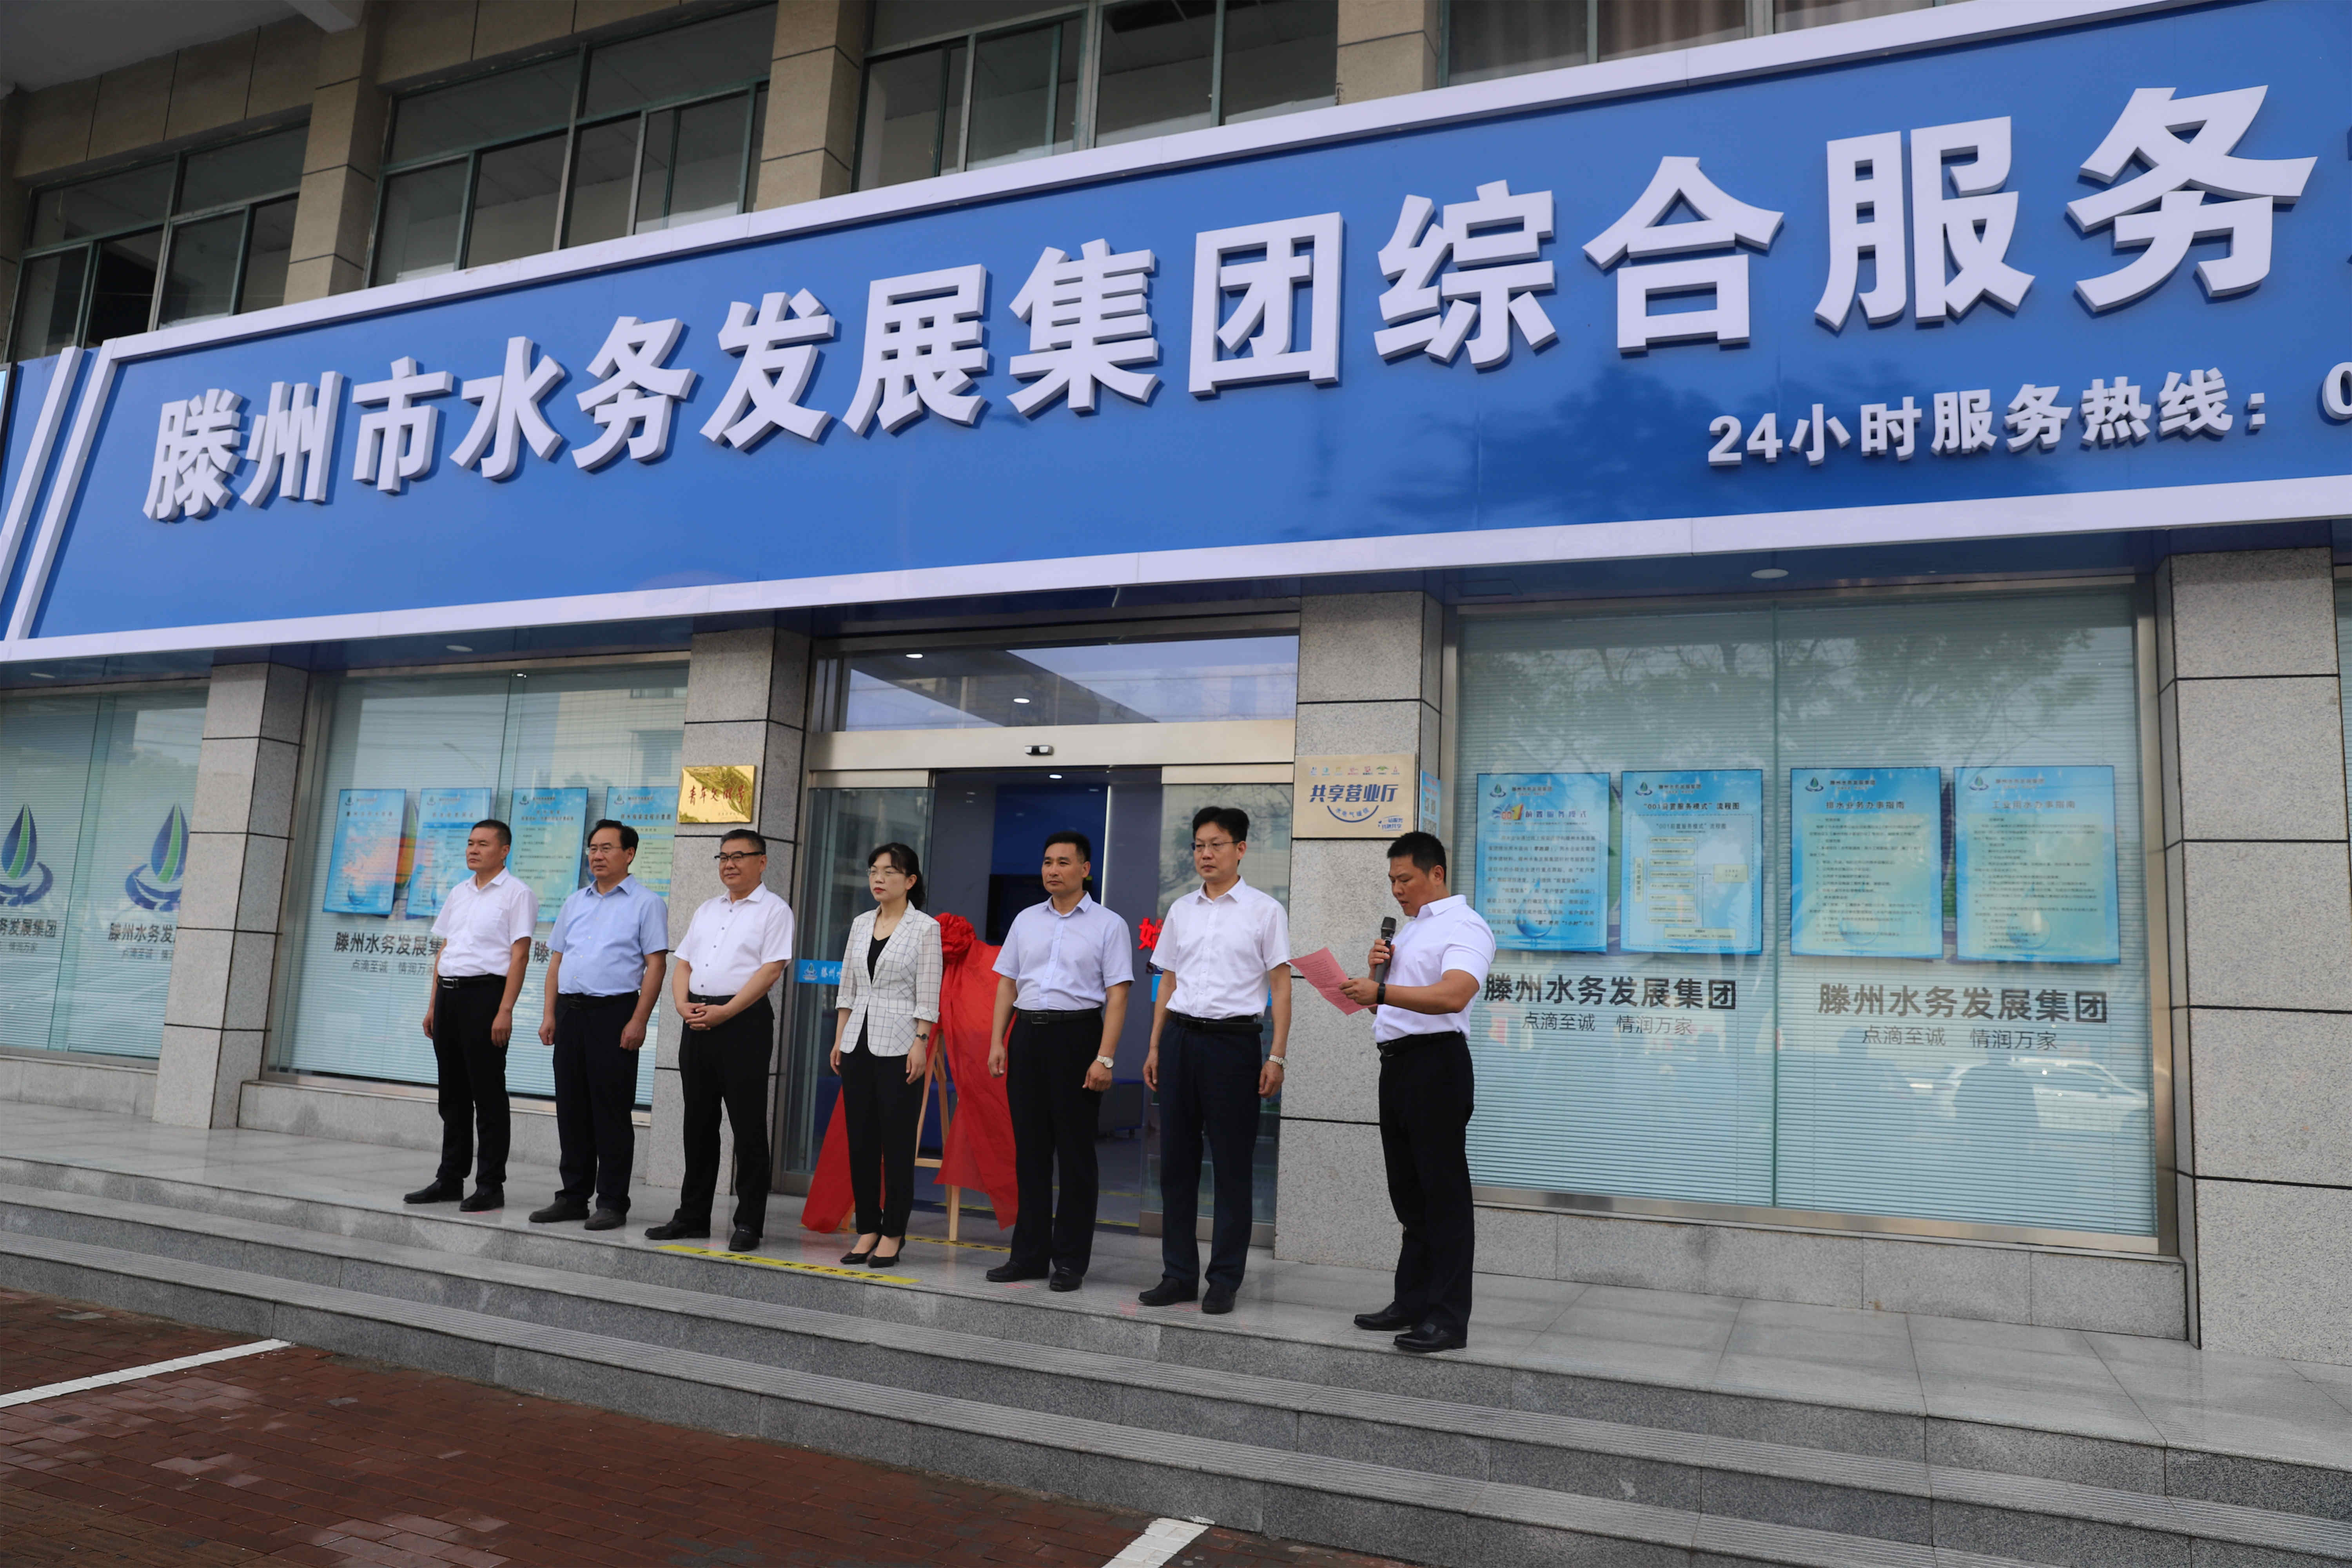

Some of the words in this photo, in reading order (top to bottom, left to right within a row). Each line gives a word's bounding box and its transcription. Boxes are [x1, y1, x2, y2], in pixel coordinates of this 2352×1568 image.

[143, 85, 2318, 521] 滕州市水务发展集团综合服务
[689, 784, 745, 806] 青年文明号
[1309, 784, 1399, 802] 共享营业厅
[108, 923, 176, 943] 滕州水务发
[352, 959, 388, 973] 点滴至诚
[1483, 973, 1736, 1009] 滕州水务发展集团
[1818, 983, 2107, 1023] 滕州水务发展集团
[1522, 1011, 1596, 1031] 点滴至诚
[1616, 1014, 1693, 1035] 情润万家
[1862, 1025, 1946, 1046] 点滴至诚
[1970, 1028, 2058, 1051] 情润万家
